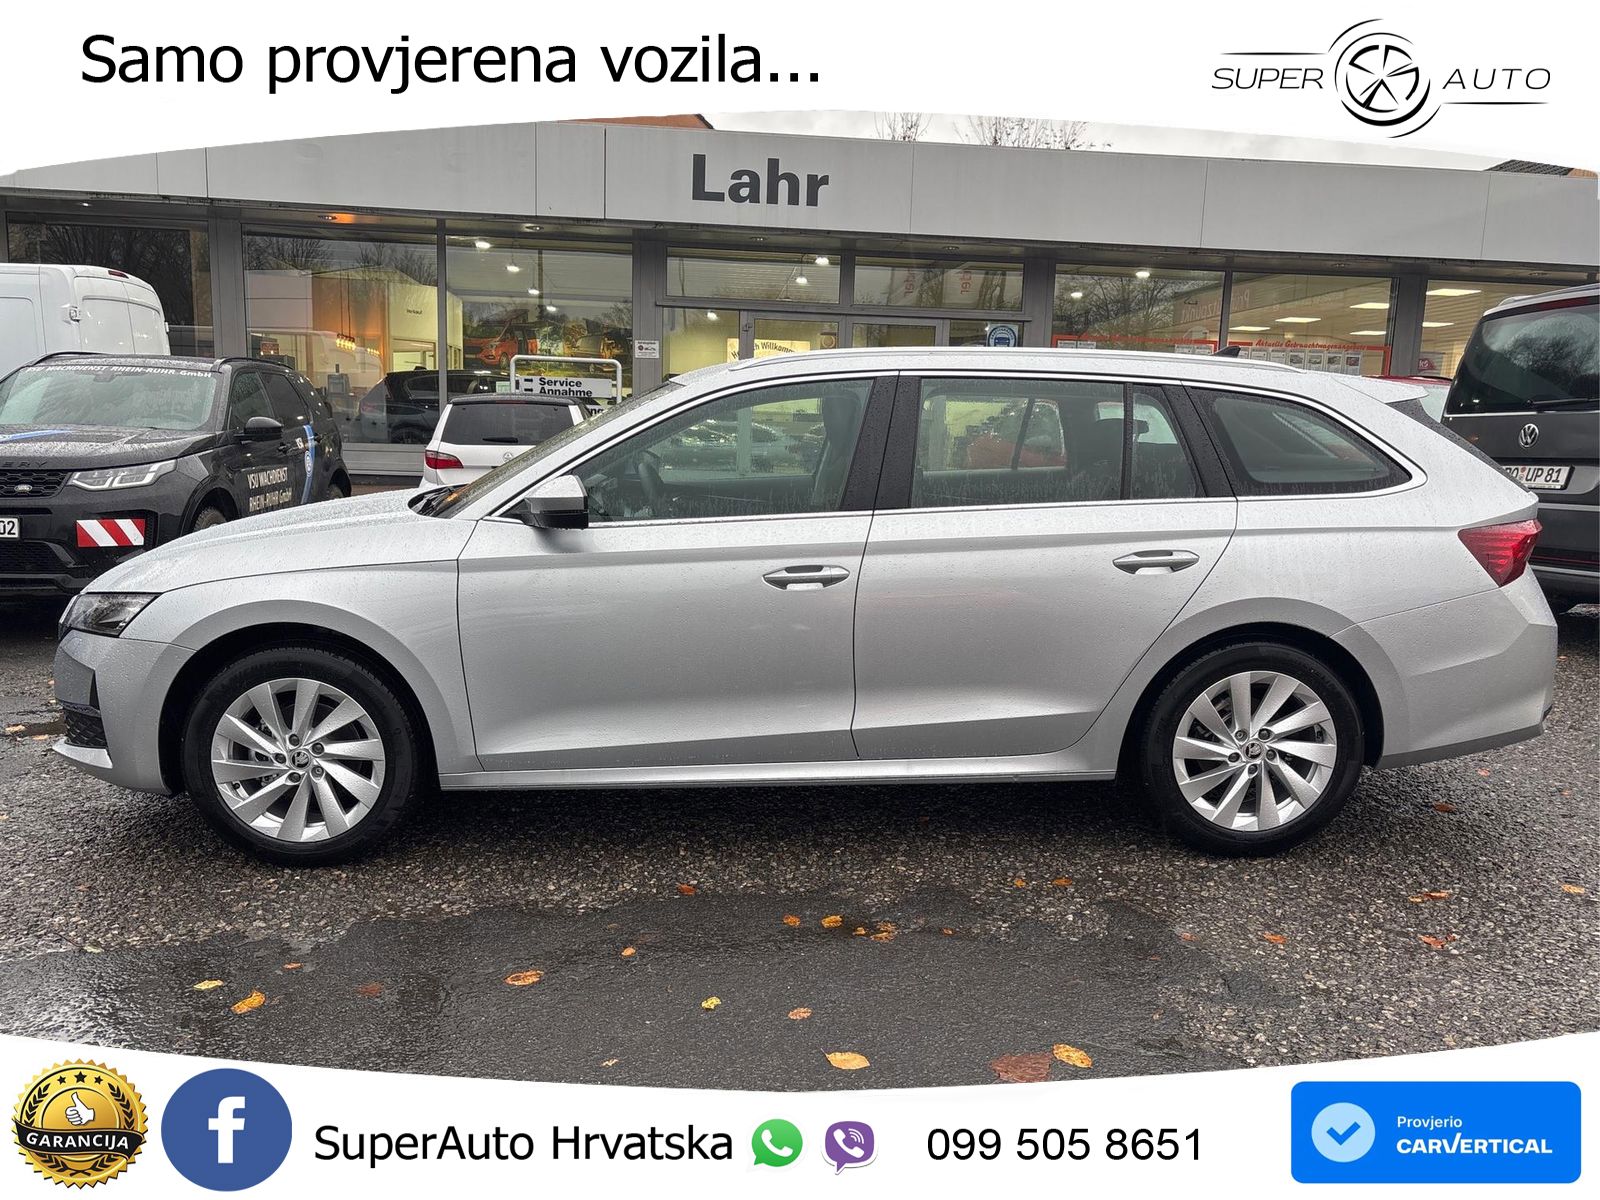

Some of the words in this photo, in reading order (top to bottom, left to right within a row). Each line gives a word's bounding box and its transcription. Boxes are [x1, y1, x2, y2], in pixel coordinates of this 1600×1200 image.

[692, 153, 830, 207] Lahr
[1255, 339, 1284, 347] Aktuelle
[110, 366, 176, 375] RHEIN-RUHR
[179, 370, 212, 378] GmbH
[538, 377, 583, 388] Service
[539, 387, 593, 397] Annahme
[247, 472, 260, 490] VSU
[260, 466, 288, 487] WACHDIENST
[1525, 467, 1544, 482] UP
[1544, 467, 1562, 483] 81
[249, 490, 279, 512] RHEIN-RUHR
[279, 487, 292, 504] GmbH
